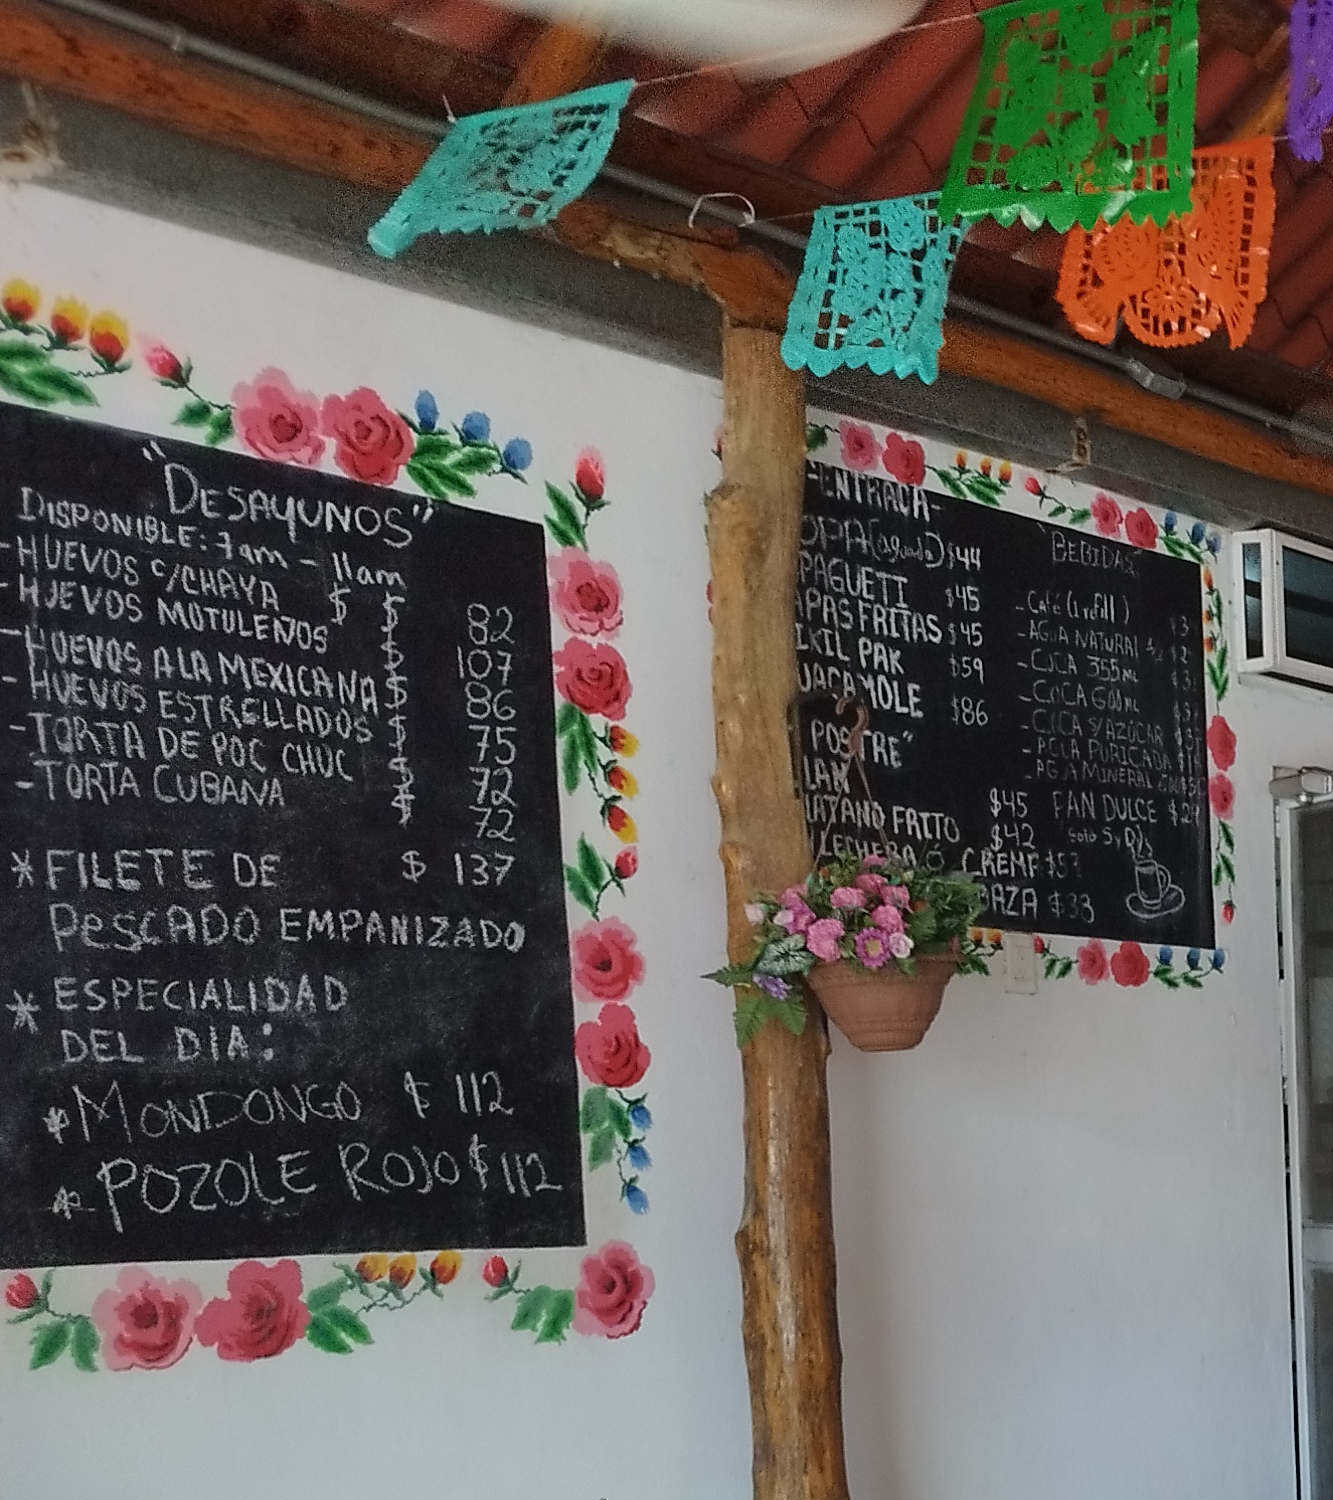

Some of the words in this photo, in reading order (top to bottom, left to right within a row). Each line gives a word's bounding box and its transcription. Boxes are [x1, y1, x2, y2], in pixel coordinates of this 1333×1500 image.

[798, 550, 908, 609] PAGUETI
[466, 602, 516, 646] 82
[859, 599, 942, 645] FRITAS
[456, 645, 514, 687] 107
[795, 623, 851, 661] IKIL
[859, 636, 904, 675] PAK
[464, 681, 517, 721] 86
[27, 712, 147, 760] TORTA
[157, 726, 201, 760] DE
[468, 767, 518, 807] 72
[468, 725, 518, 764] 75
[33, 760, 141, 805] TORTA
[153, 764, 286, 806] CUBANA
[468, 805, 516, 842] 72
[806, 794, 887, 831] LATANO
[893, 805, 961, 843] FRITO
[1102, 794, 1158, 823] DULCE
[46, 848, 215, 891] FILETE
[233, 853, 282, 888] DE
[454, 852, 515, 887] 137
[279, 907, 526, 953] EMPANIZADO
[54, 975, 349, 1013] ESPECIALIDAD
[60, 1029, 146, 1064] DEL
[455, 1071, 514, 1116] 112
[96, 1149, 318, 1233] POZOLE
[338, 1142, 459, 1201] ROJO
